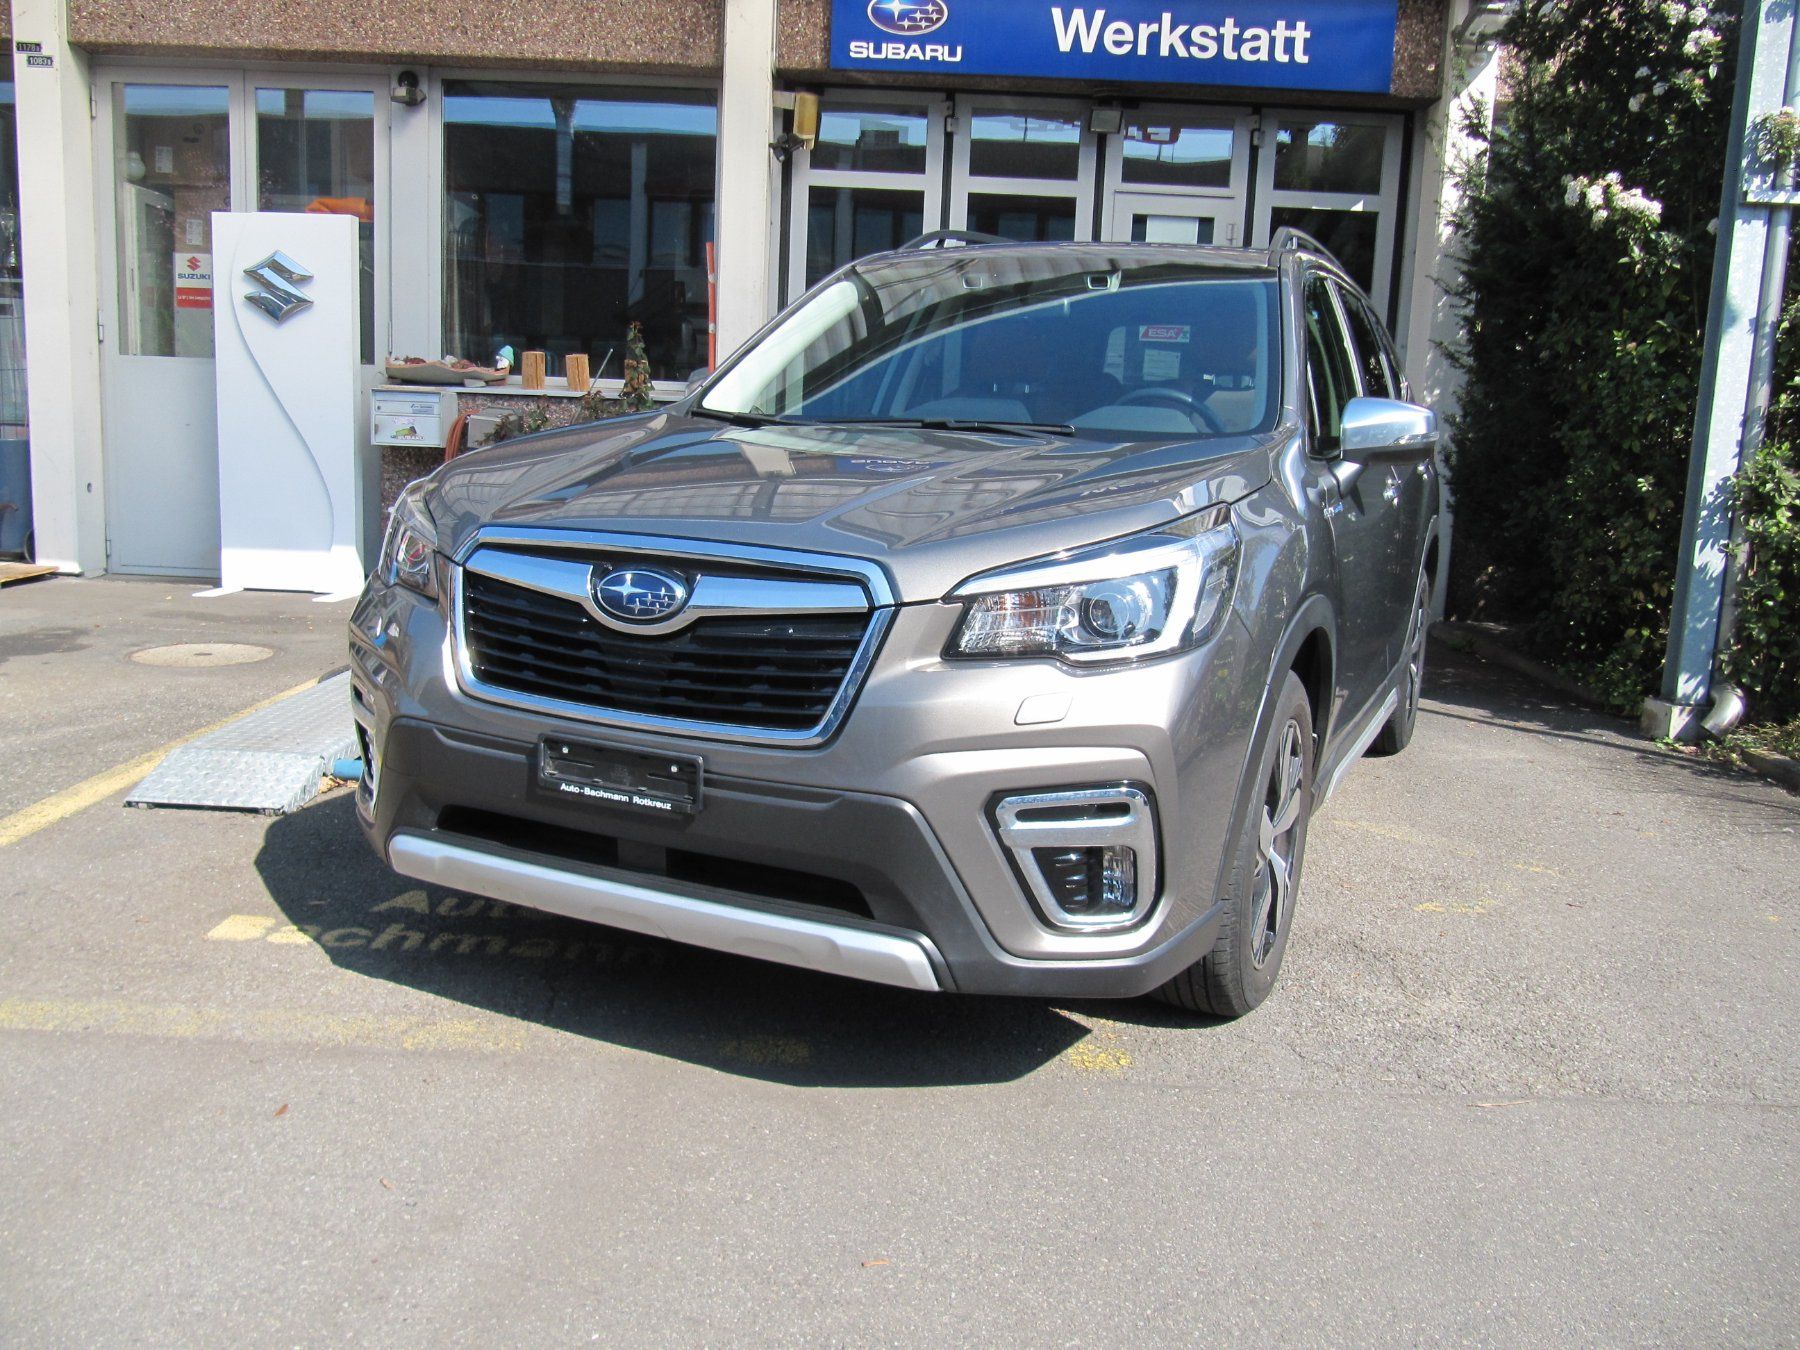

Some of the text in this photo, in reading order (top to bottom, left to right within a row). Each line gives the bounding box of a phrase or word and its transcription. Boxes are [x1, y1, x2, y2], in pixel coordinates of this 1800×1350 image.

[1051, 7, 1311, 64] Werkstatt
[849, 41, 962, 62] SUBARU
[1148, 328, 1176, 338] ESA
[633, 795, 672, 810] Rotkreuz
